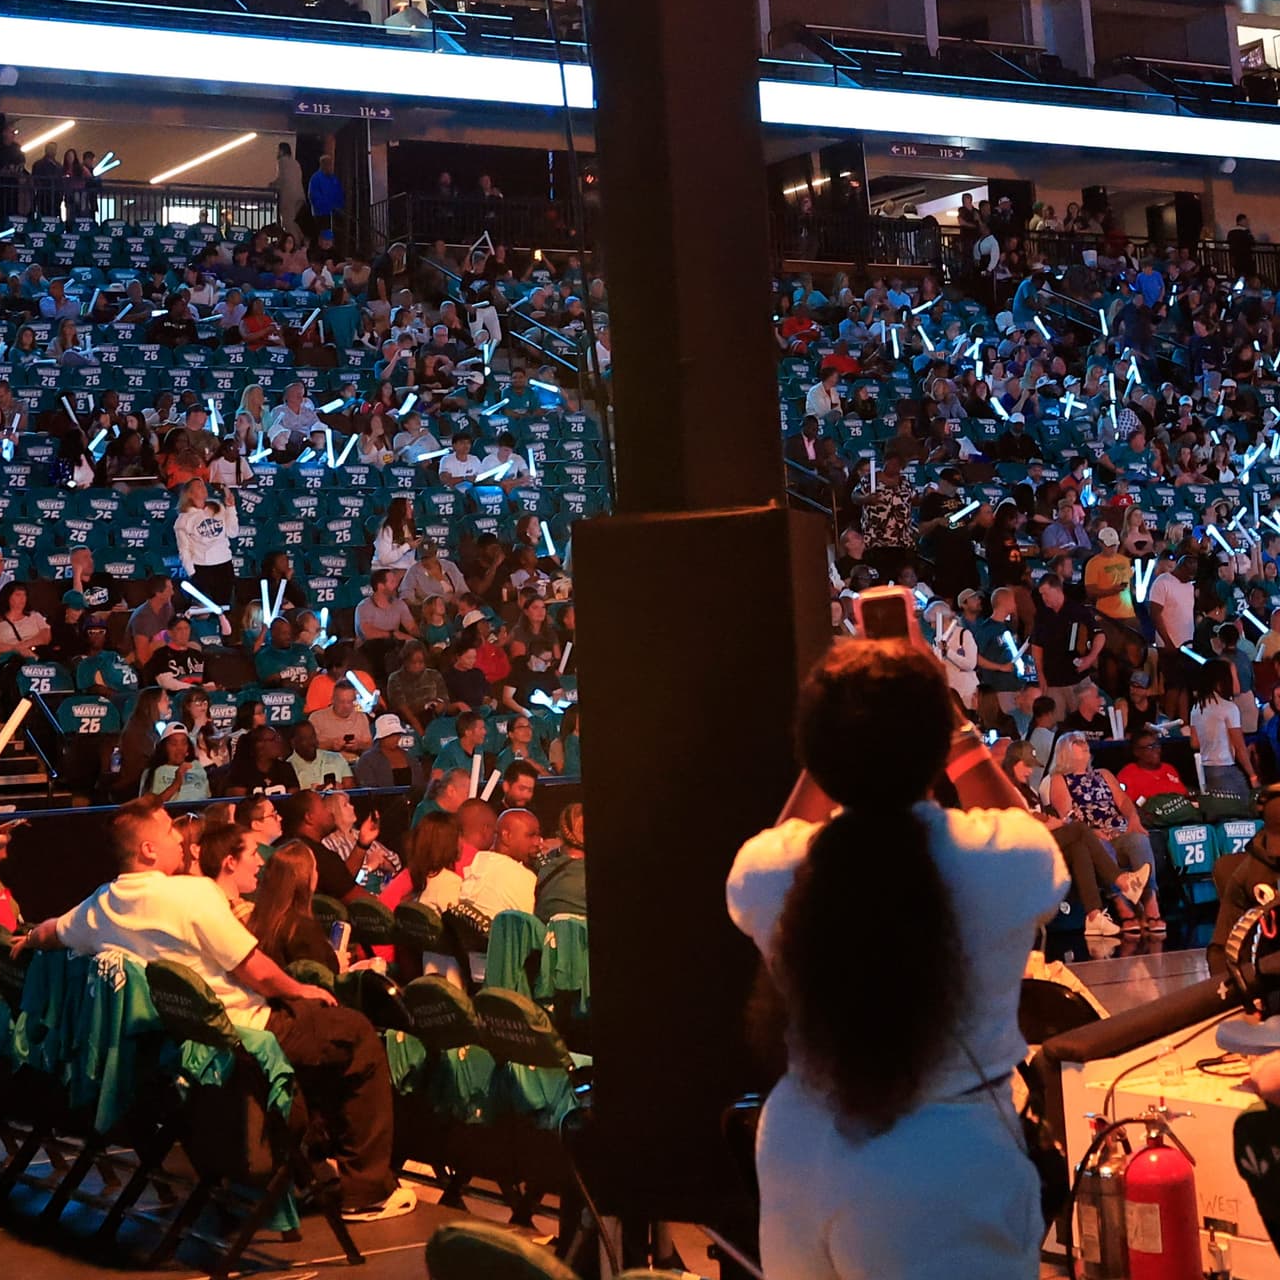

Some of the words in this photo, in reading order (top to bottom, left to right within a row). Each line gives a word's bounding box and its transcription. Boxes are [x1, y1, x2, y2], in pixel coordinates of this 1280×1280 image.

[312, 103, 331, 114] 113
[360, 107, 377, 117] 114
[902, 146, 917, 155] 114
[144, 352, 157, 360] 26
[42, 376, 55, 386] 26
[86, 375, 99, 385] 26
[129, 376, 142, 385] 26
[174, 377, 187, 386] 26
[218, 379, 231, 388] 26
[18, 535, 35, 547] 26
[70, 530, 87, 542] 26
[317, 589, 334, 601] 26
[30, 678, 53, 693] 26
[271, 706, 291, 720] 26
[1175, 826, 1206, 844] WAVES
[1224, 821, 1255, 837] WAVES
[1185, 844, 1204, 865] 26
